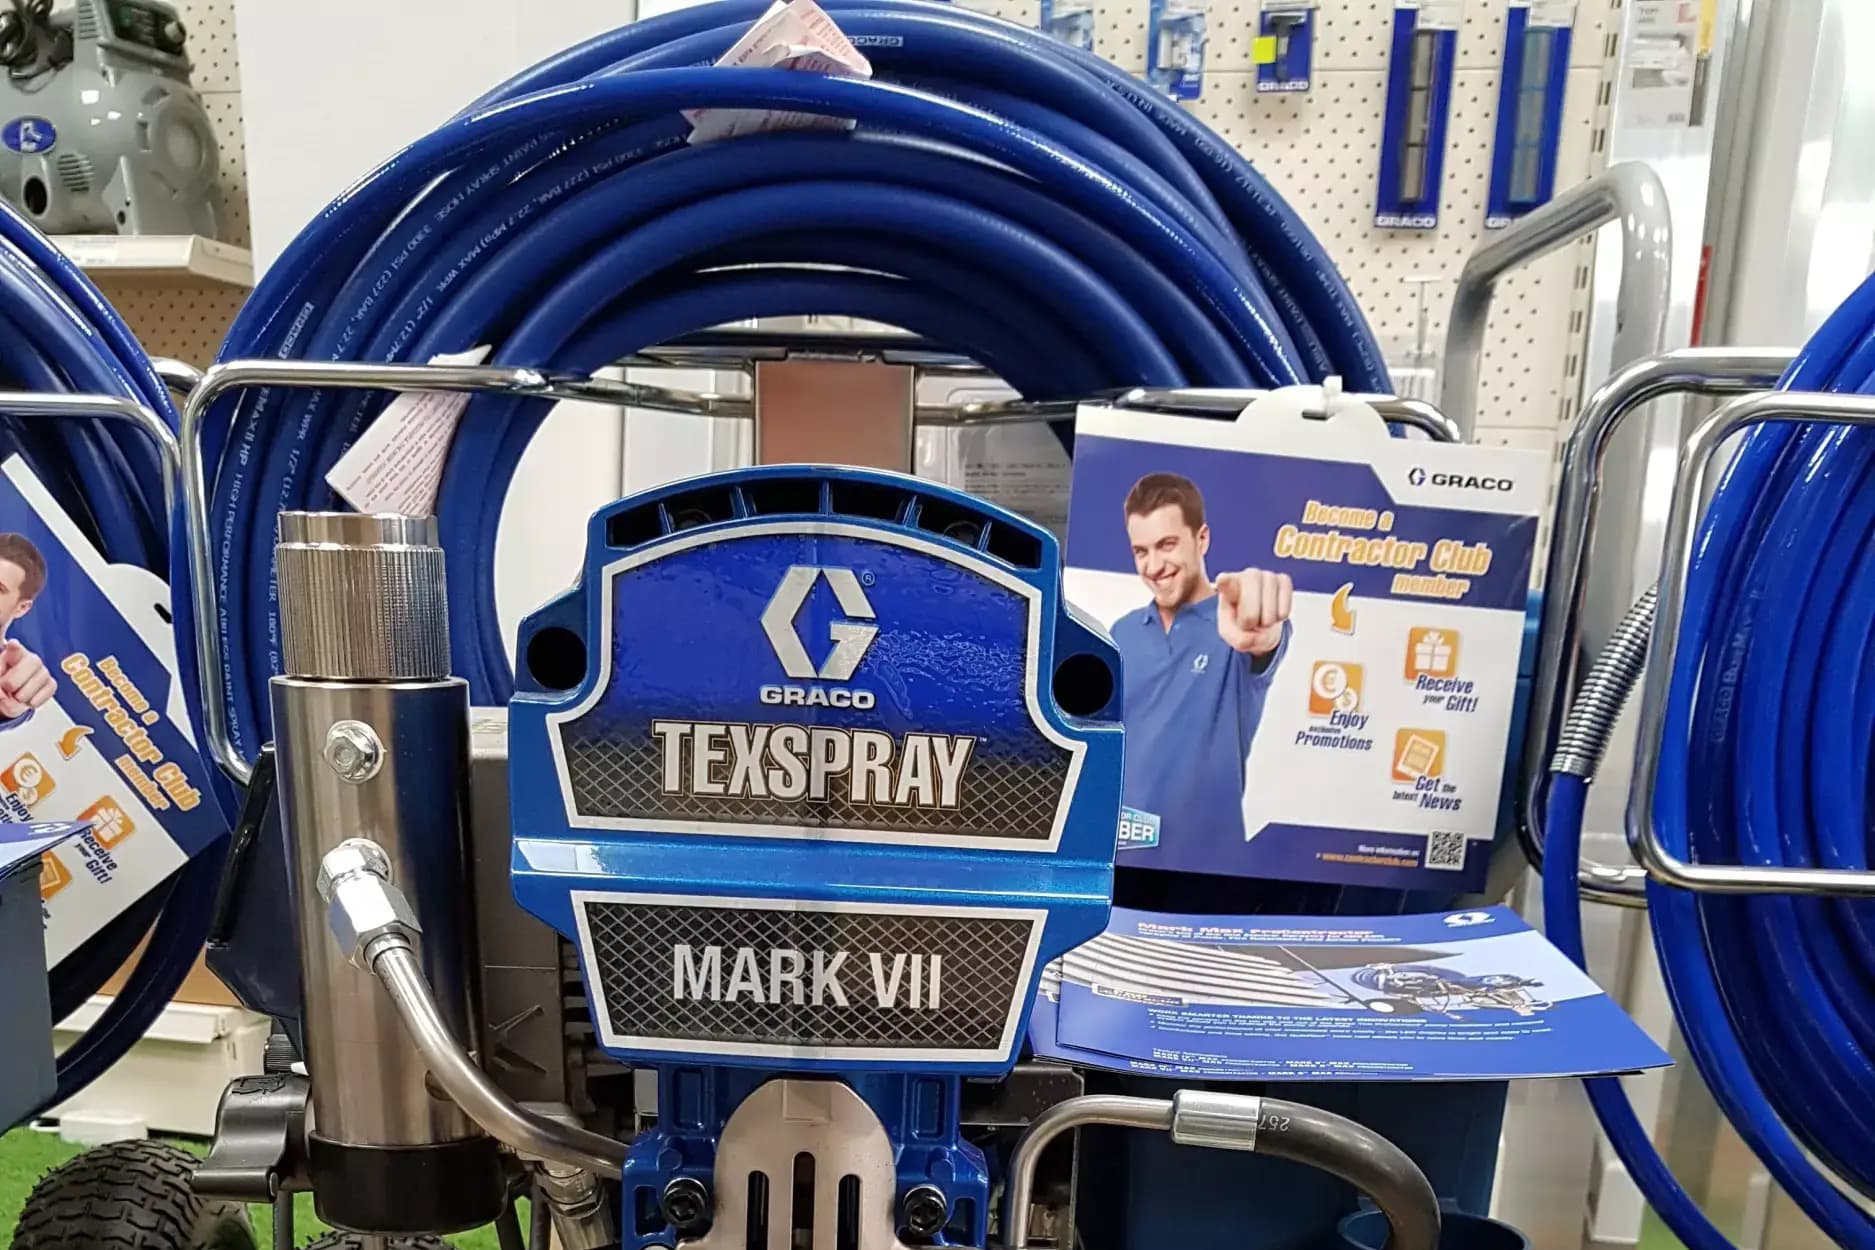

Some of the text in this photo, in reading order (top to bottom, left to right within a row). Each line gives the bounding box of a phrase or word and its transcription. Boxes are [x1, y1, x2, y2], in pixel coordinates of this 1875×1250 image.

[1376, 215, 1437, 228] GRACO
[239, 443, 252, 467] HP
[229, 472, 244, 509] HIGH
[1431, 473, 1514, 492] GRACO
[1302, 500, 1395, 532] Become a
[218, 509, 236, 602] PERFORMANCE
[1273, 524, 1493, 576] Contractor Club
[1391, 573, 1471, 600] member
[96, 655, 160, 725] Become a
[1415, 674, 1474, 695] Receive
[759, 686, 876, 710] GRACO
[1421, 693, 1480, 714] your Gift!
[61, 652, 201, 812] Contractor Club
[1329, 709, 1370, 731] Enjoy
[1295, 731, 1374, 751] Promotions
[653, 720, 976, 809] TEXSPRAY
[114, 754, 170, 811] member
[1415, 775, 1442, 794] Get
[5, 792, 35, 823] Enjoy
[1418, 793, 1463, 812] News
[1118, 820, 1155, 841] BER
[79, 826, 118, 872] Receive
[85, 859, 113, 885] Gift!
[673, 943, 943, 1011] MARK VII
[1257, 1113, 1291, 1132] 257
